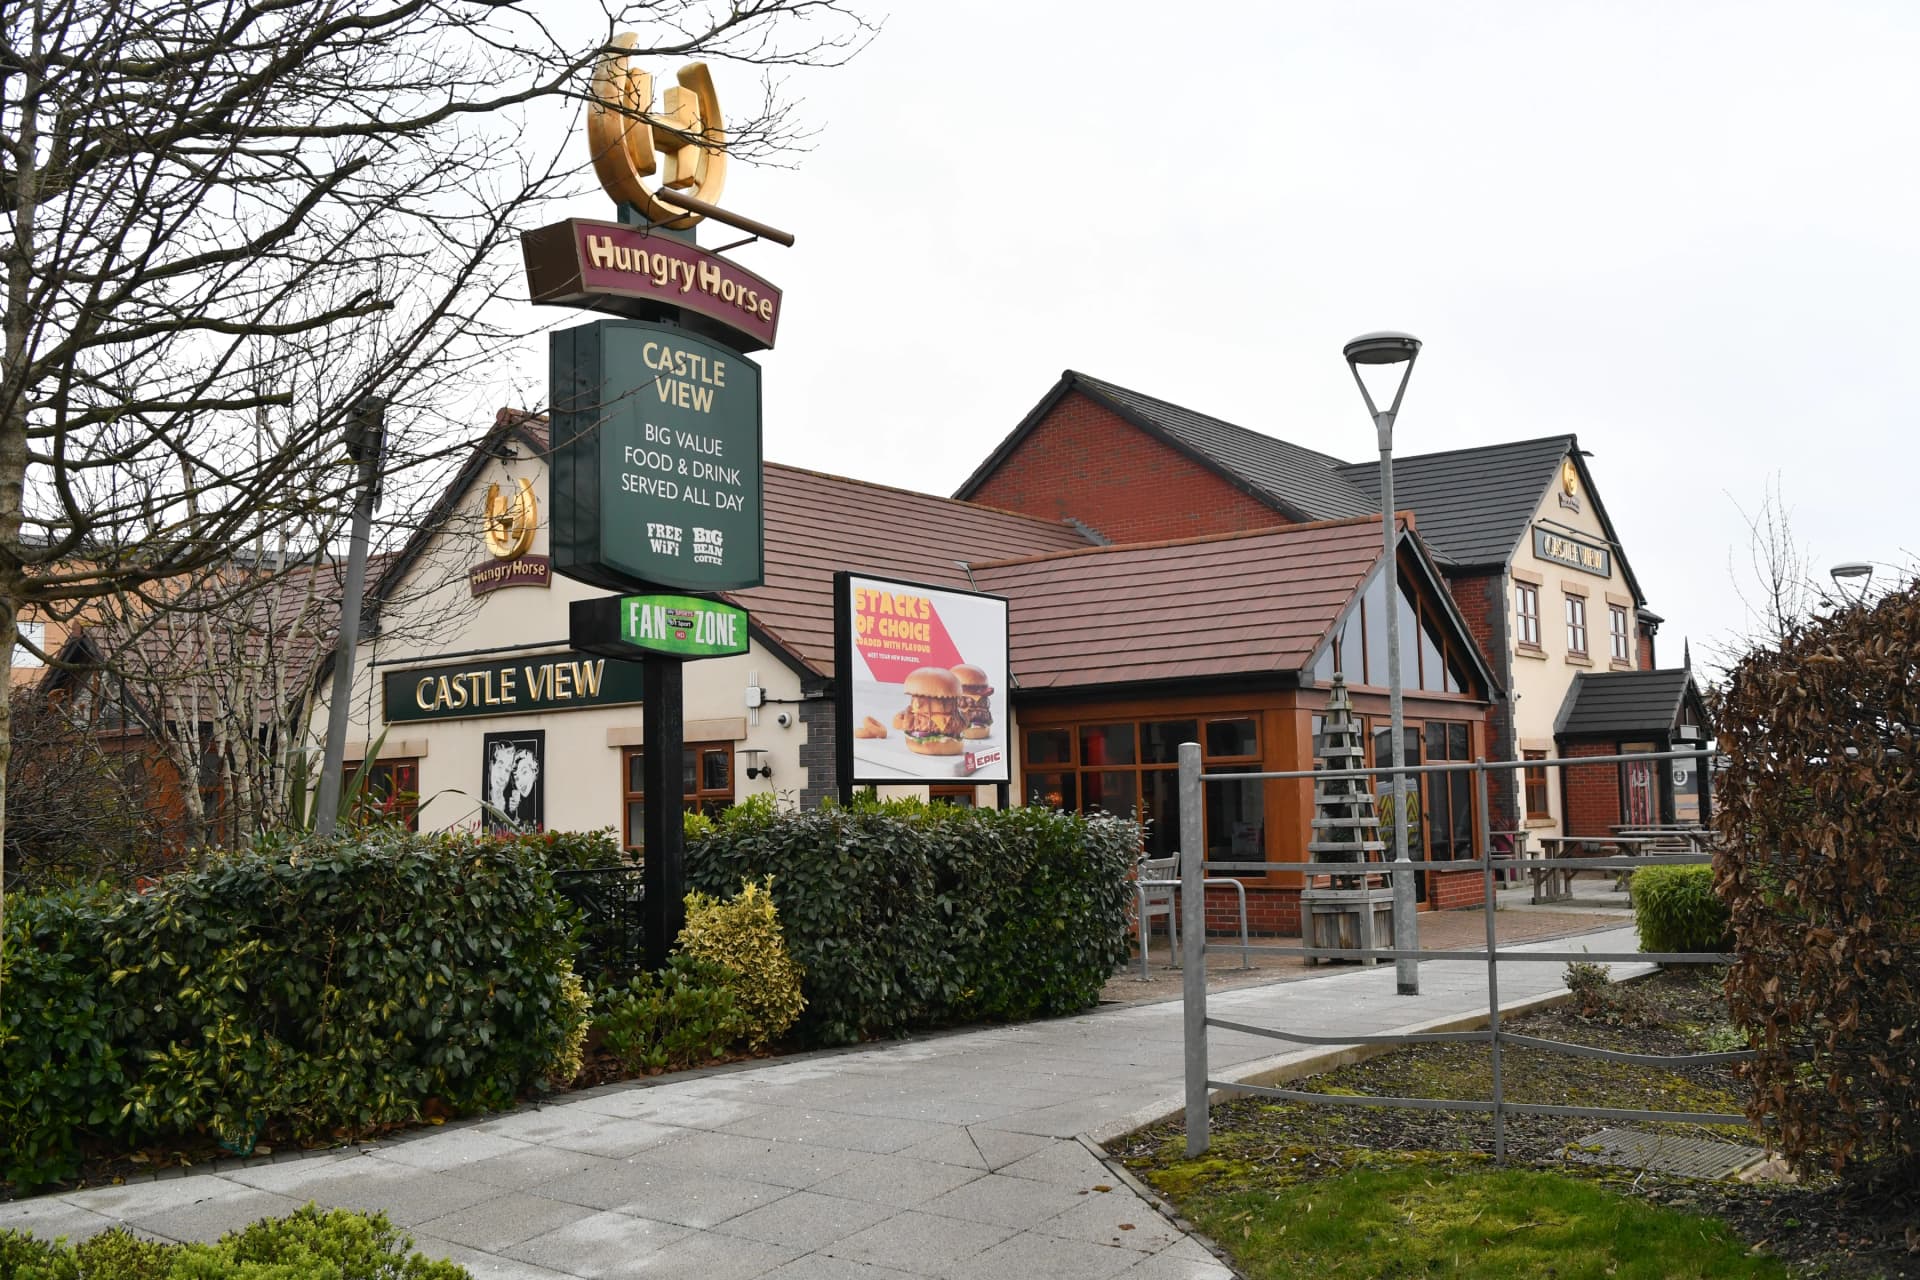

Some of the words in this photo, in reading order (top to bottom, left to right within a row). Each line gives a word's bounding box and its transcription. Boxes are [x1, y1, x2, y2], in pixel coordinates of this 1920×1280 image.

[642, 342, 725, 388] CASTLE
[655, 375, 714, 414] VIEW
[645, 423, 671, 445] BIG
[675, 430, 723, 456] VALUE
[624, 446, 673, 472] FOOD
[677, 458, 688, 476] &
[693, 460, 741, 487] DRINK
[621, 473, 678, 500] SERVED
[682, 485, 711, 506] ALL
[715, 491, 745, 512] DAY
[647, 522, 683, 543] FREE
[650, 539, 680, 557] WiFi
[692, 527, 723, 546] BIG
[693, 543, 723, 557] BEAN
[694, 555, 723, 566] COFFEE
[1544, 534, 1579, 562] CASTLE
[1578, 544, 1603, 569] VIEW
[855, 588, 930, 620] STACKS
[630, 602, 667, 640] FAN
[695, 610, 737, 647] ZONE
[856, 614, 875, 634] OF
[879, 617, 930, 642] CHOICE
[883, 640, 900, 650] WITH
[416, 669, 517, 711] CASTLE
[525, 659, 605, 701] VIEW
[976, 752, 1001, 766] EPIC
